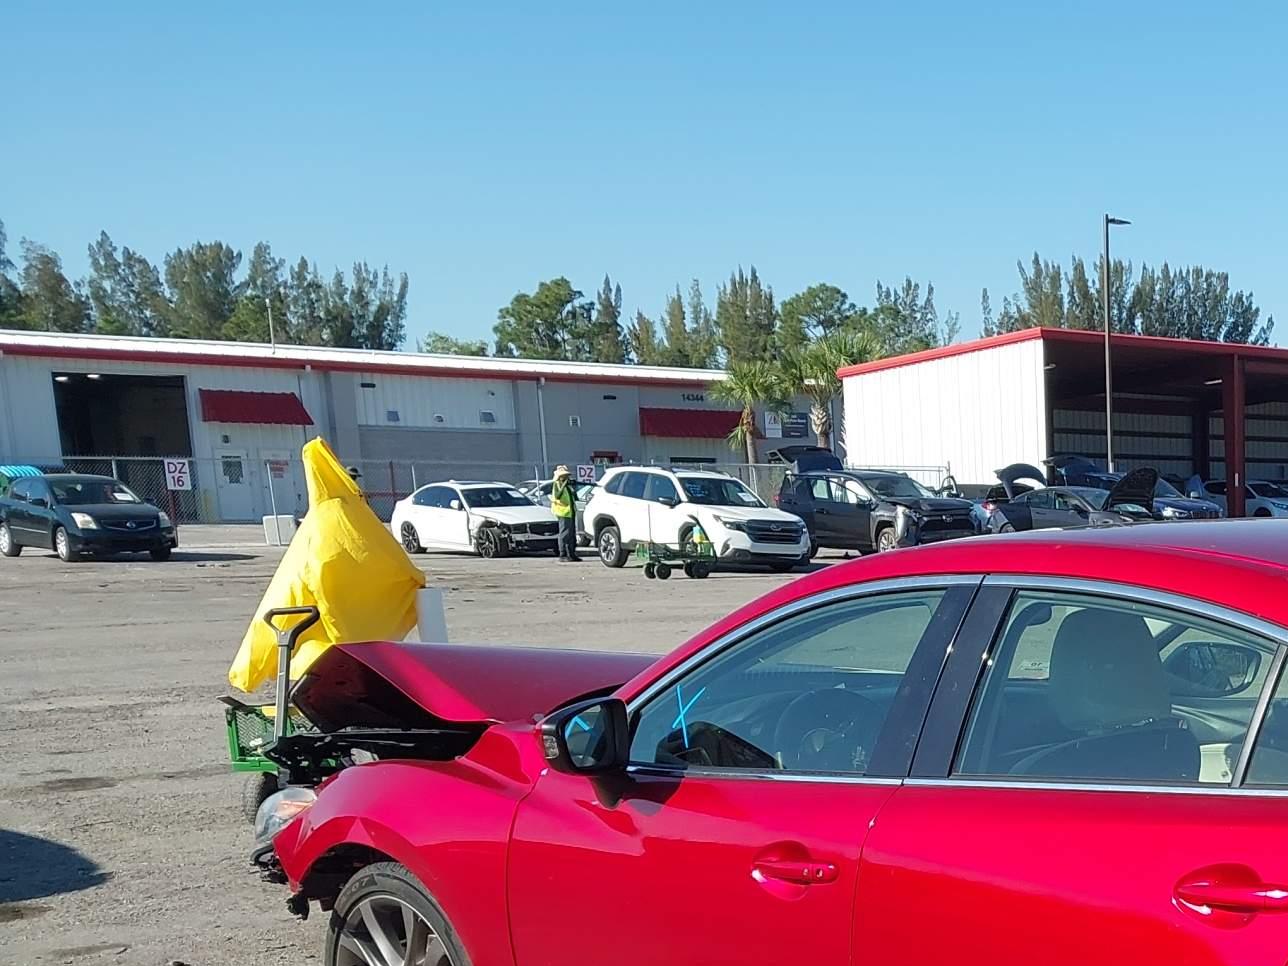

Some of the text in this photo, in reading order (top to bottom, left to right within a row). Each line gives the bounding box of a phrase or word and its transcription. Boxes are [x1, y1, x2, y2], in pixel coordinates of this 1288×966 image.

[167, 462, 187, 474] DZ
[578, 466, 594, 478] DZ
[171, 475, 185, 488] 16
